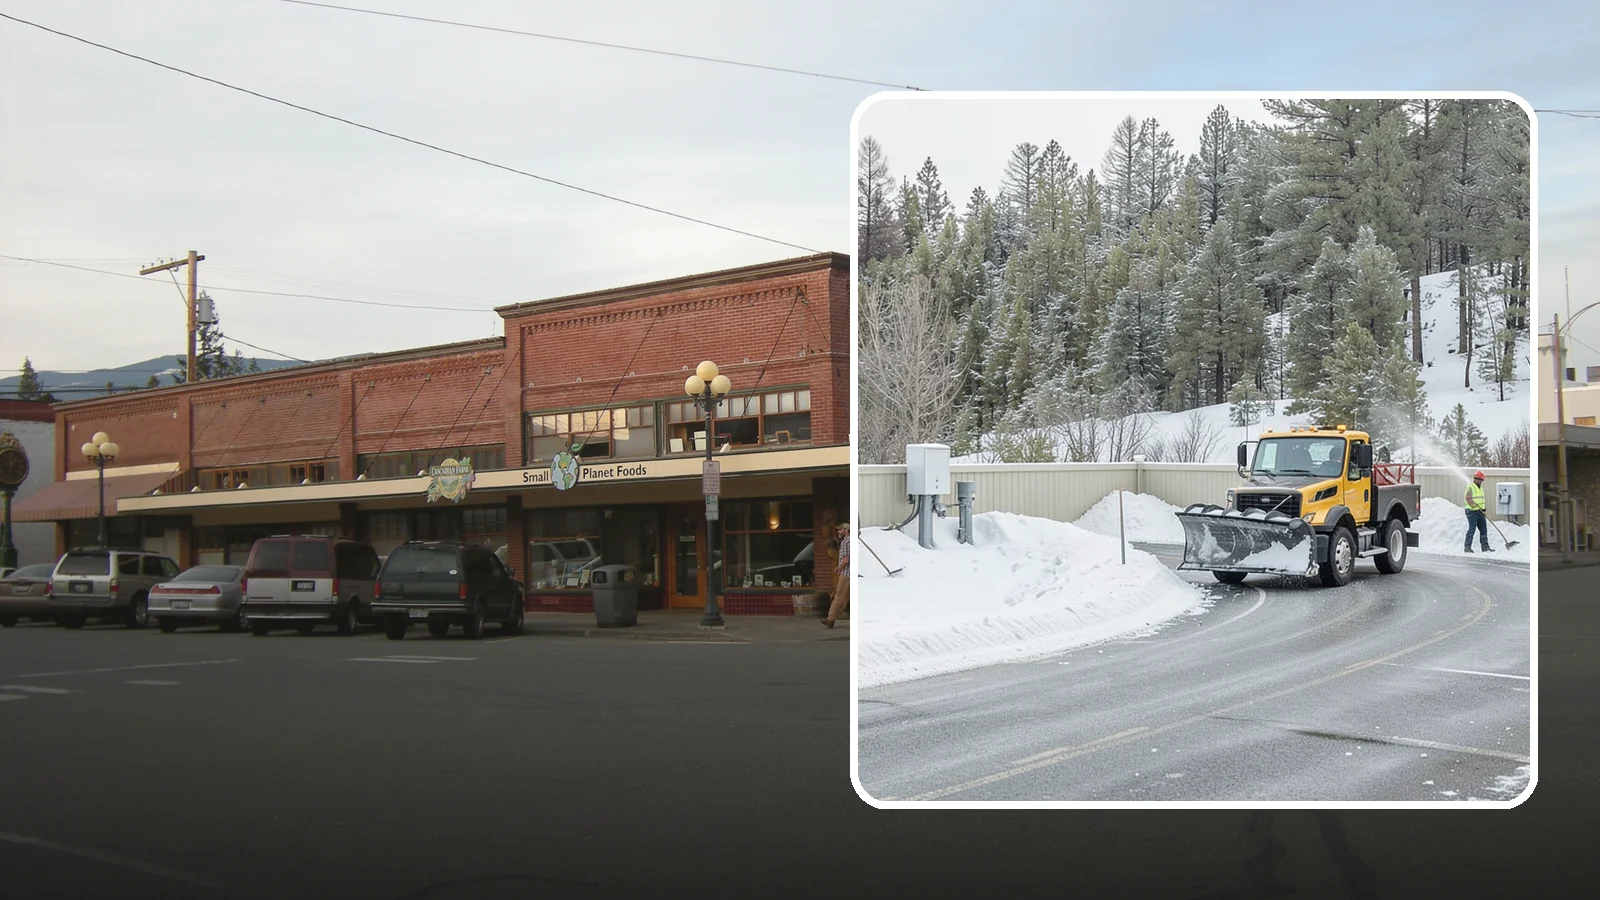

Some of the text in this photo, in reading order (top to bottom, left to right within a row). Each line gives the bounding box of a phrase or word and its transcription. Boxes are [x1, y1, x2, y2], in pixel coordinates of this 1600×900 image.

[523, 464, 647, 483] Small Planet Foods
